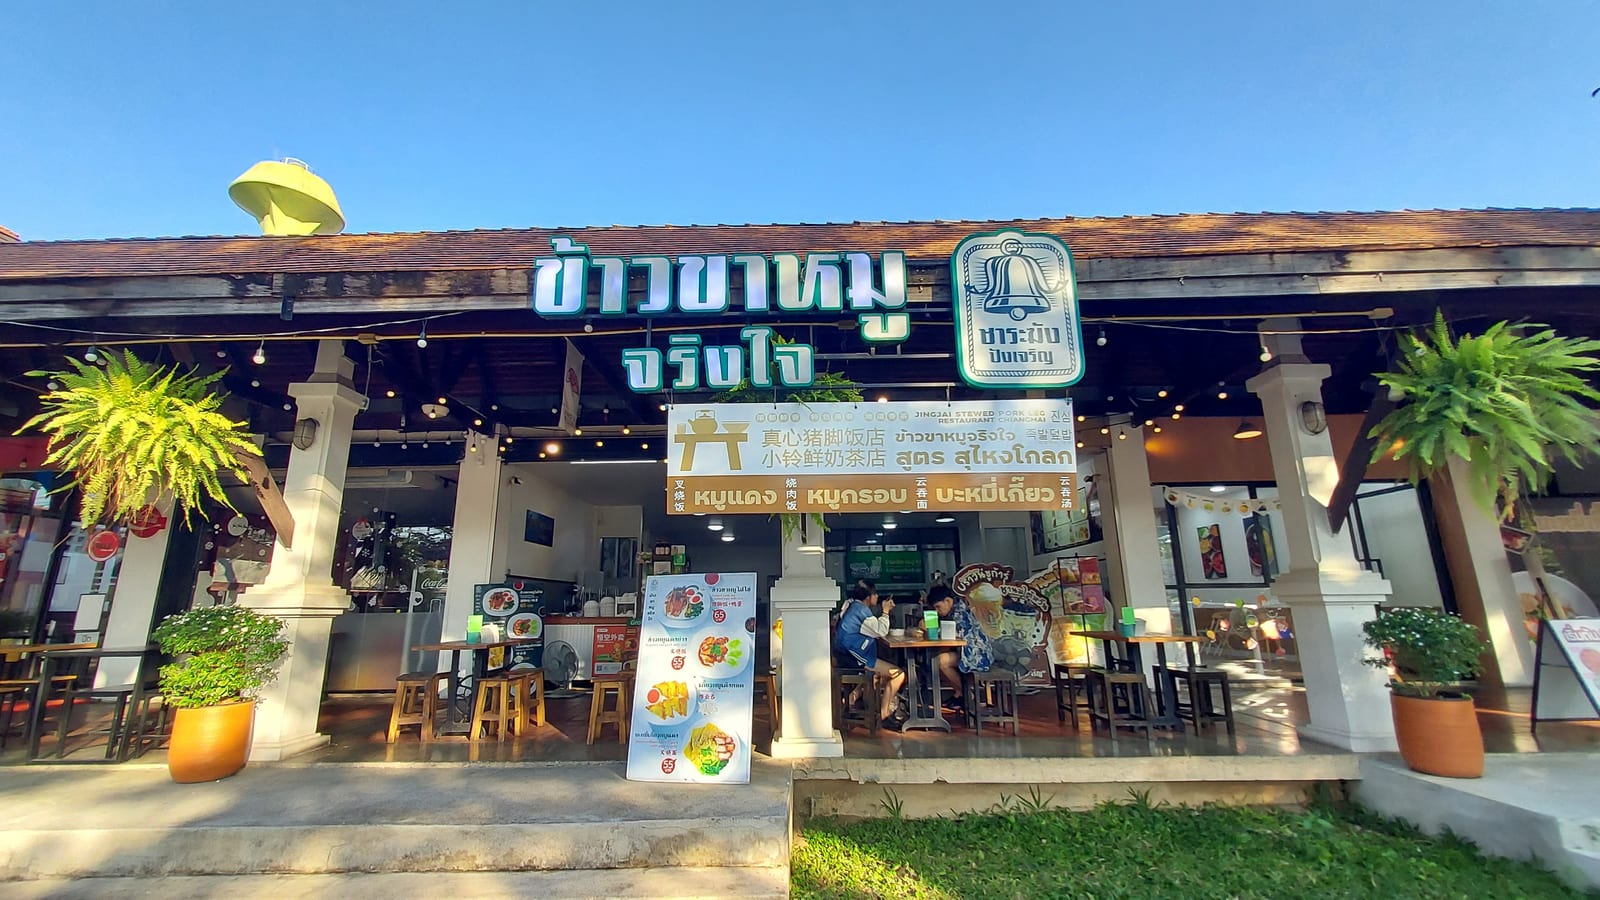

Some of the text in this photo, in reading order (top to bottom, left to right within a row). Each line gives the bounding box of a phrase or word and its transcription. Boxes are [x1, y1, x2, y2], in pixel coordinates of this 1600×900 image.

[533, 236, 910, 342] ข้าวขาหมู
[979, 322, 1060, 344] ชาระฆัง
[622, 327, 814, 392] จริงใจ
[989, 348, 1053, 365] ปังเจริญ
[1051, 410, 1071, 423] 진심
[762, 428, 886, 447] 真心猪脚饭店
[895, 428, 1016, 445] ข้าวขาหมูจริงใจ
[761, 448, 886, 468] 小铃鲜奶茶店
[896, 443, 1073, 471] สูตร สุไหงโกลก
[673, 479, 686, 512] 叉烧饭
[694, 489, 778, 511] หมูแดง
[785, 477, 798, 511] 烧肉饭
[807, 487, 907, 510] หมูกรอบ
[915, 476, 928, 509] 云吞面
[935, 476, 1055, 503] บะหมี่เกี๊ยว
[1059, 476, 1072, 508] 云吞汤
[714, 610, 724, 618] 65
[673, 657, 683, 666] 55
[663, 760, 674, 768] 55
